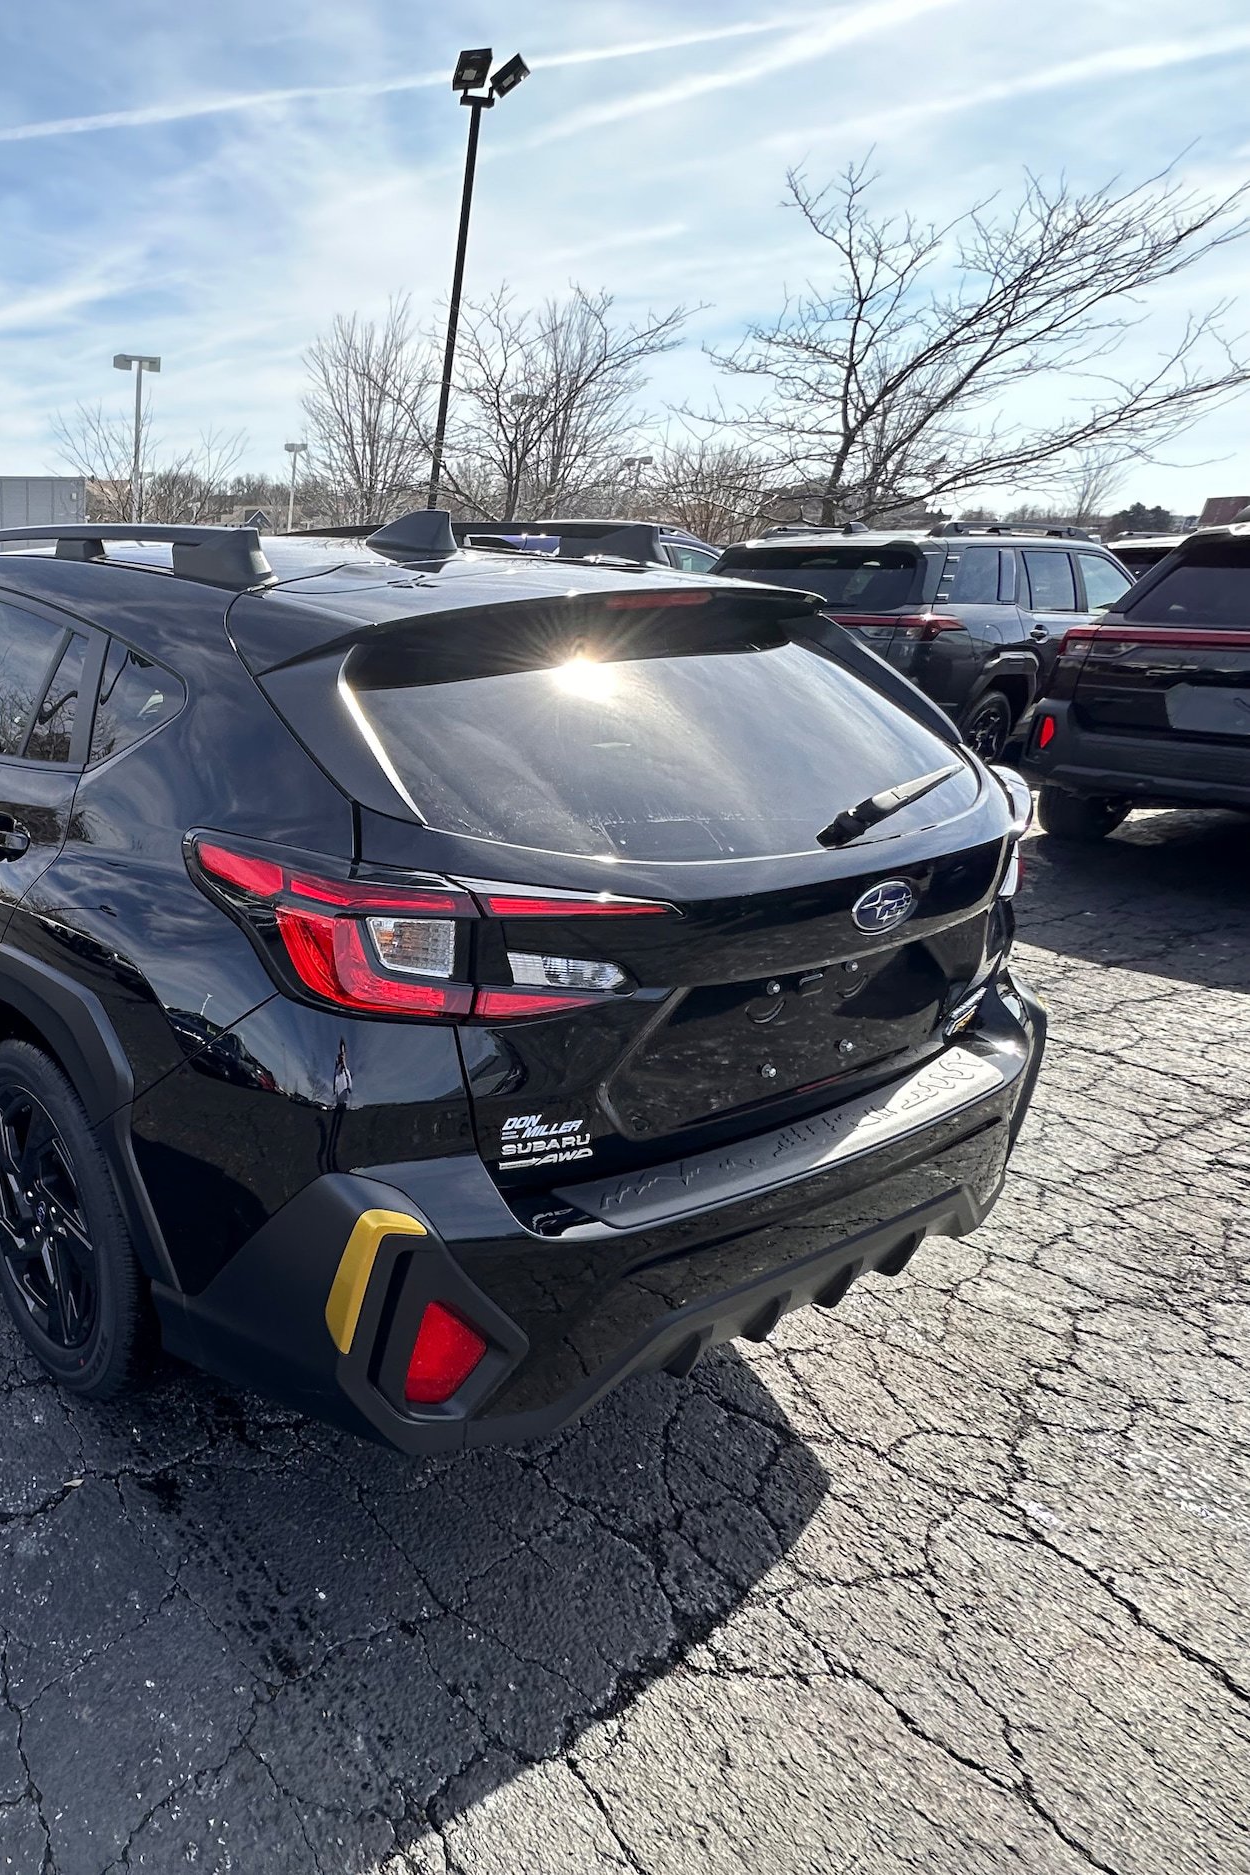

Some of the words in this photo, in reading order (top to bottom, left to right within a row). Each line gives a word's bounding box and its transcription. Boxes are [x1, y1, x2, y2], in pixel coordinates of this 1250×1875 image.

[502, 1114, 543, 1131] DON
[521, 1119, 584, 1139] MILLER
[501, 1133, 591, 1156] SUBARU
[534, 1147, 594, 1166] AWD
